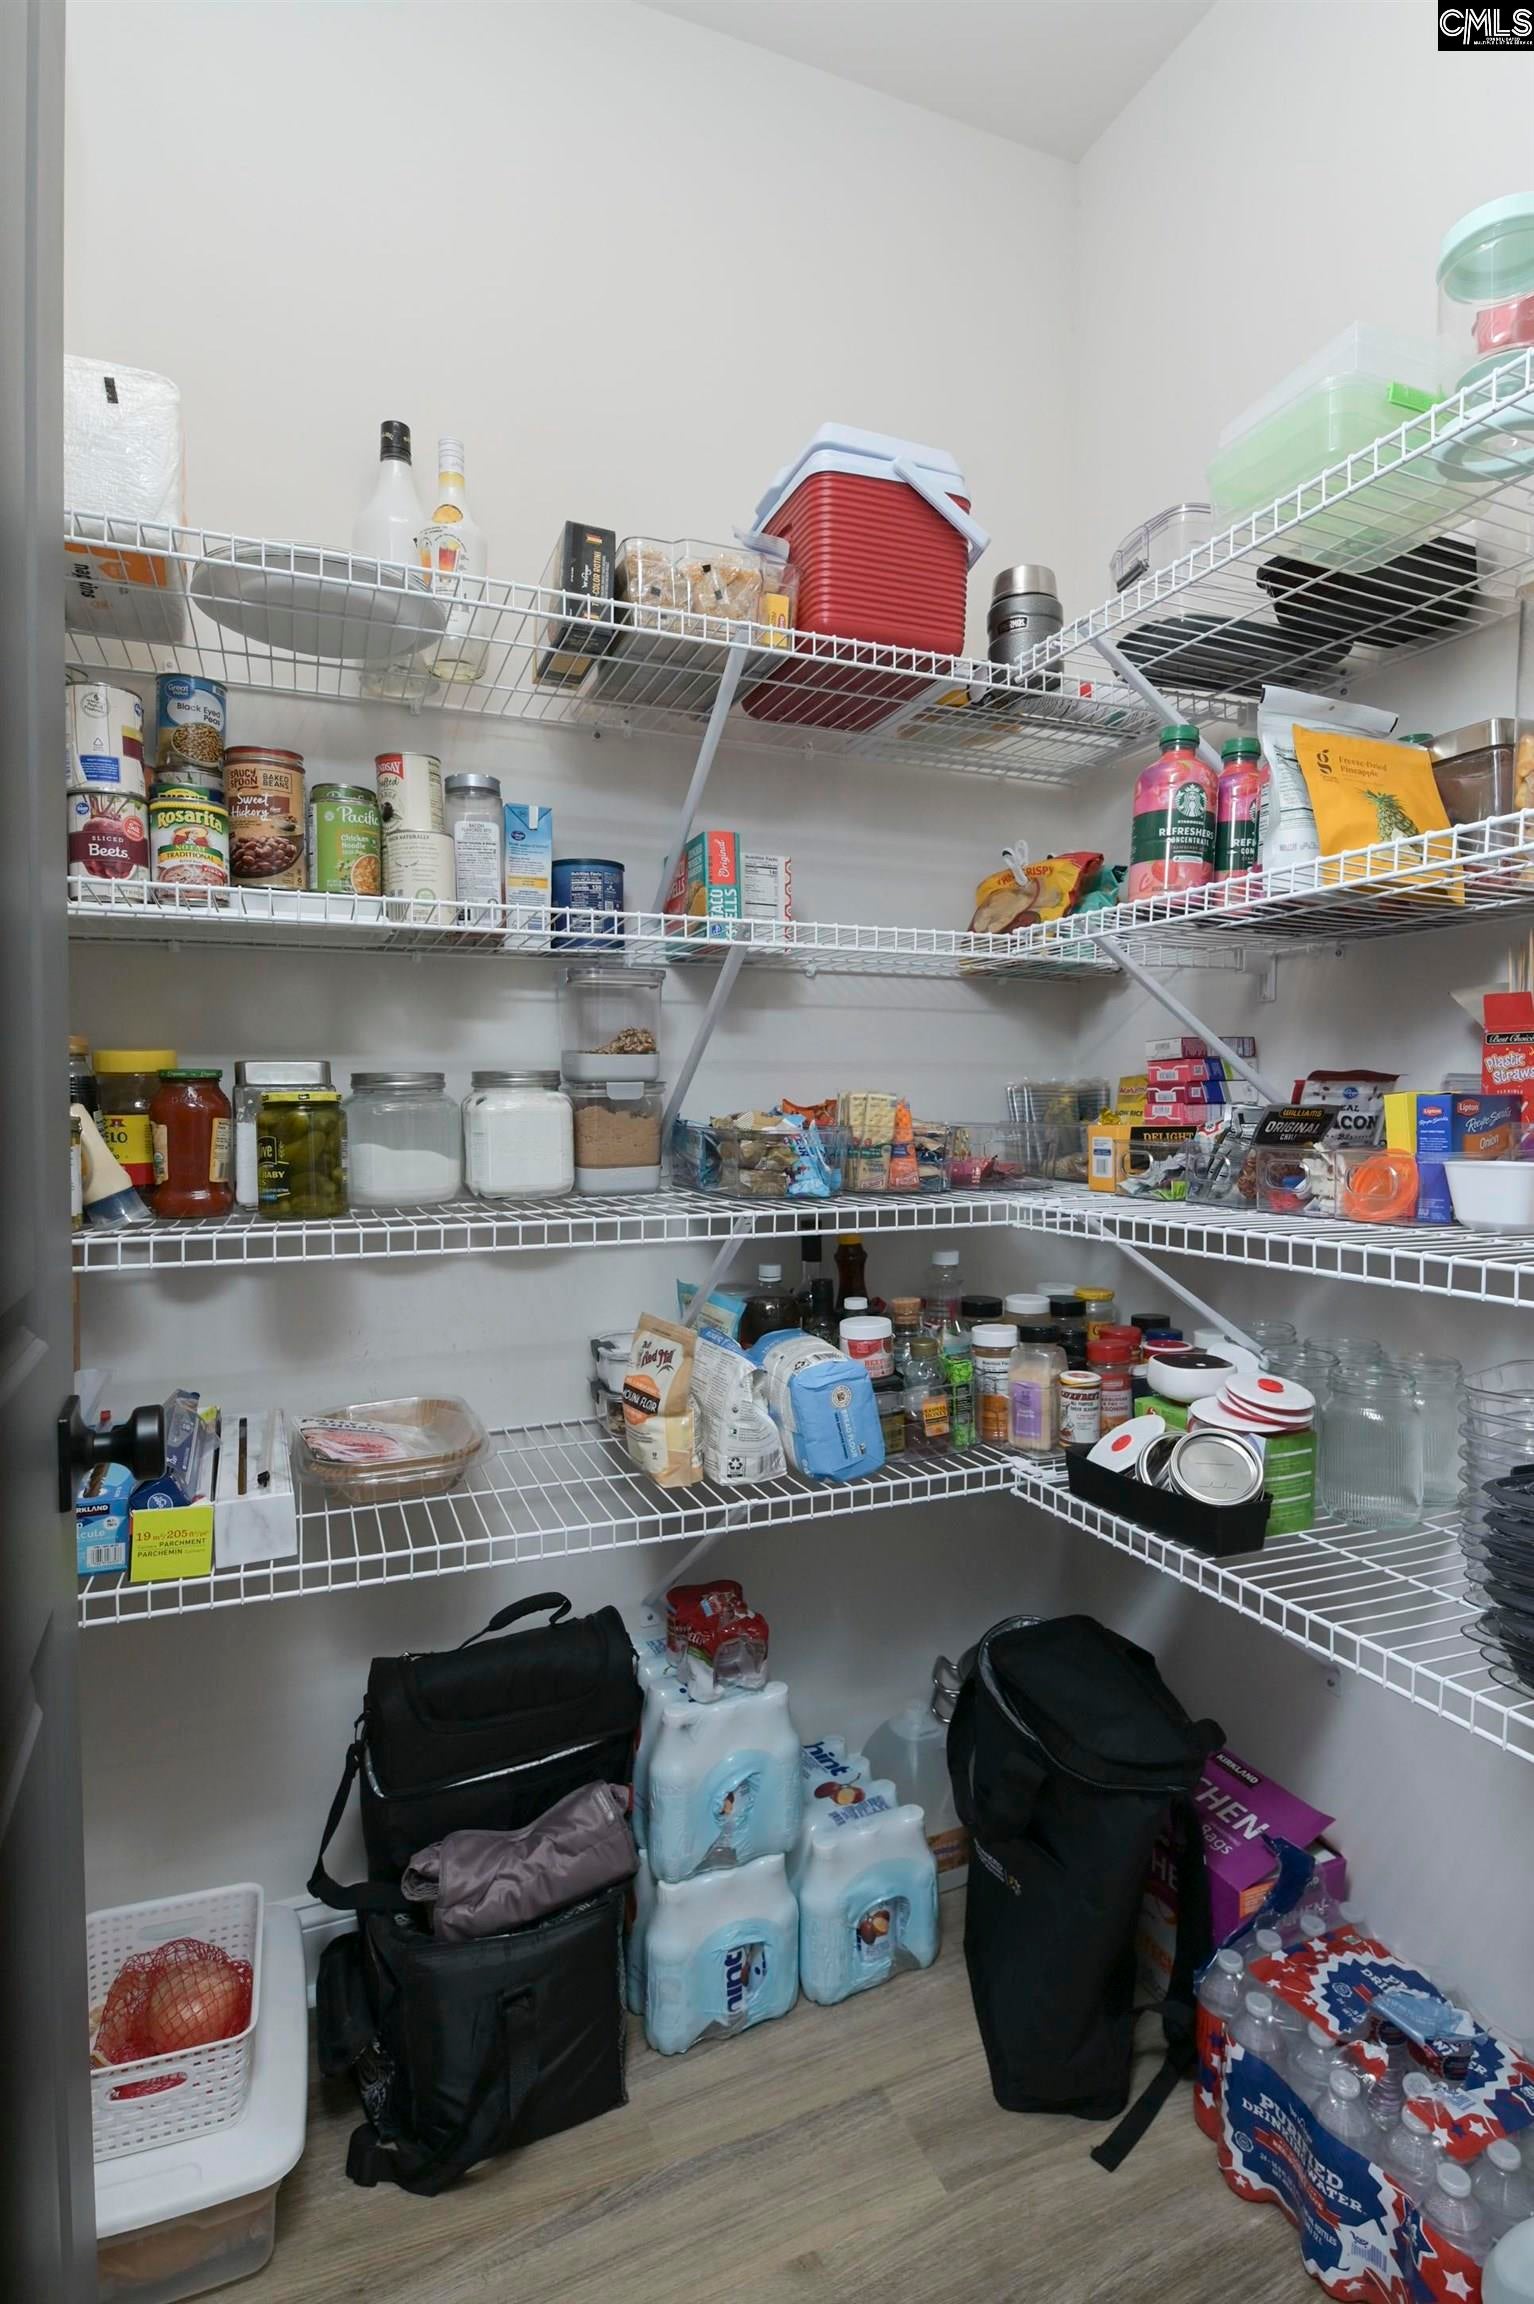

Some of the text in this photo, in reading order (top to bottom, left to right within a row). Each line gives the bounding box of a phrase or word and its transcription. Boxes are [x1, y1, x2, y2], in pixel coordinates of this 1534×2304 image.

[592, 551, 602, 572] ROTINI
[177, 702, 221, 719] Black Eyed
[203, 715, 221, 726] Peas
[230, 768, 257, 780] SAUCY
[263, 774, 289, 783] BAKED
[230, 777, 258, 788] SPOON
[263, 780, 289, 789] BEANS
[237, 792, 272, 806] Sweet
[231, 806, 271, 821] Hickory
[336, 806, 379, 825] Pacific
[157, 810, 223, 832] Rosarita
[92, 835, 124, 843] SLICED
[1159, 827, 1214, 840] RFRESHERS
[1168, 836, 1209, 846] ONCENTRATE
[88, 844, 129, 858] Beets
[167, 851, 215, 862] TRADITIONAL
[718, 839, 730, 878] Original
[724, 888, 738, 940] SELLS
[1283, 1109, 1322, 1118] WILLIAMS
[1341, 1104, 1360, 1112] EAL
[1459, 1103, 1479, 1112] Lipton
[1265, 1120, 1321, 1133] ORIGINAL
[1334, 1116, 1378, 1130] ACON
[1143, 1131, 1195, 1142] DELIGHT
[1480, 1134, 1499, 1150] Onion
[76, 1505, 108, 1514] RKLAND
[138, 1531, 151, 1541] 19
[159, 1538, 207, 1548] PARCHMENT
[137, 1549, 183, 1558] PARCHEMIN
[803, 1741, 850, 1777] hint
[1216, 1753, 1259, 1784] KIRKLAND
